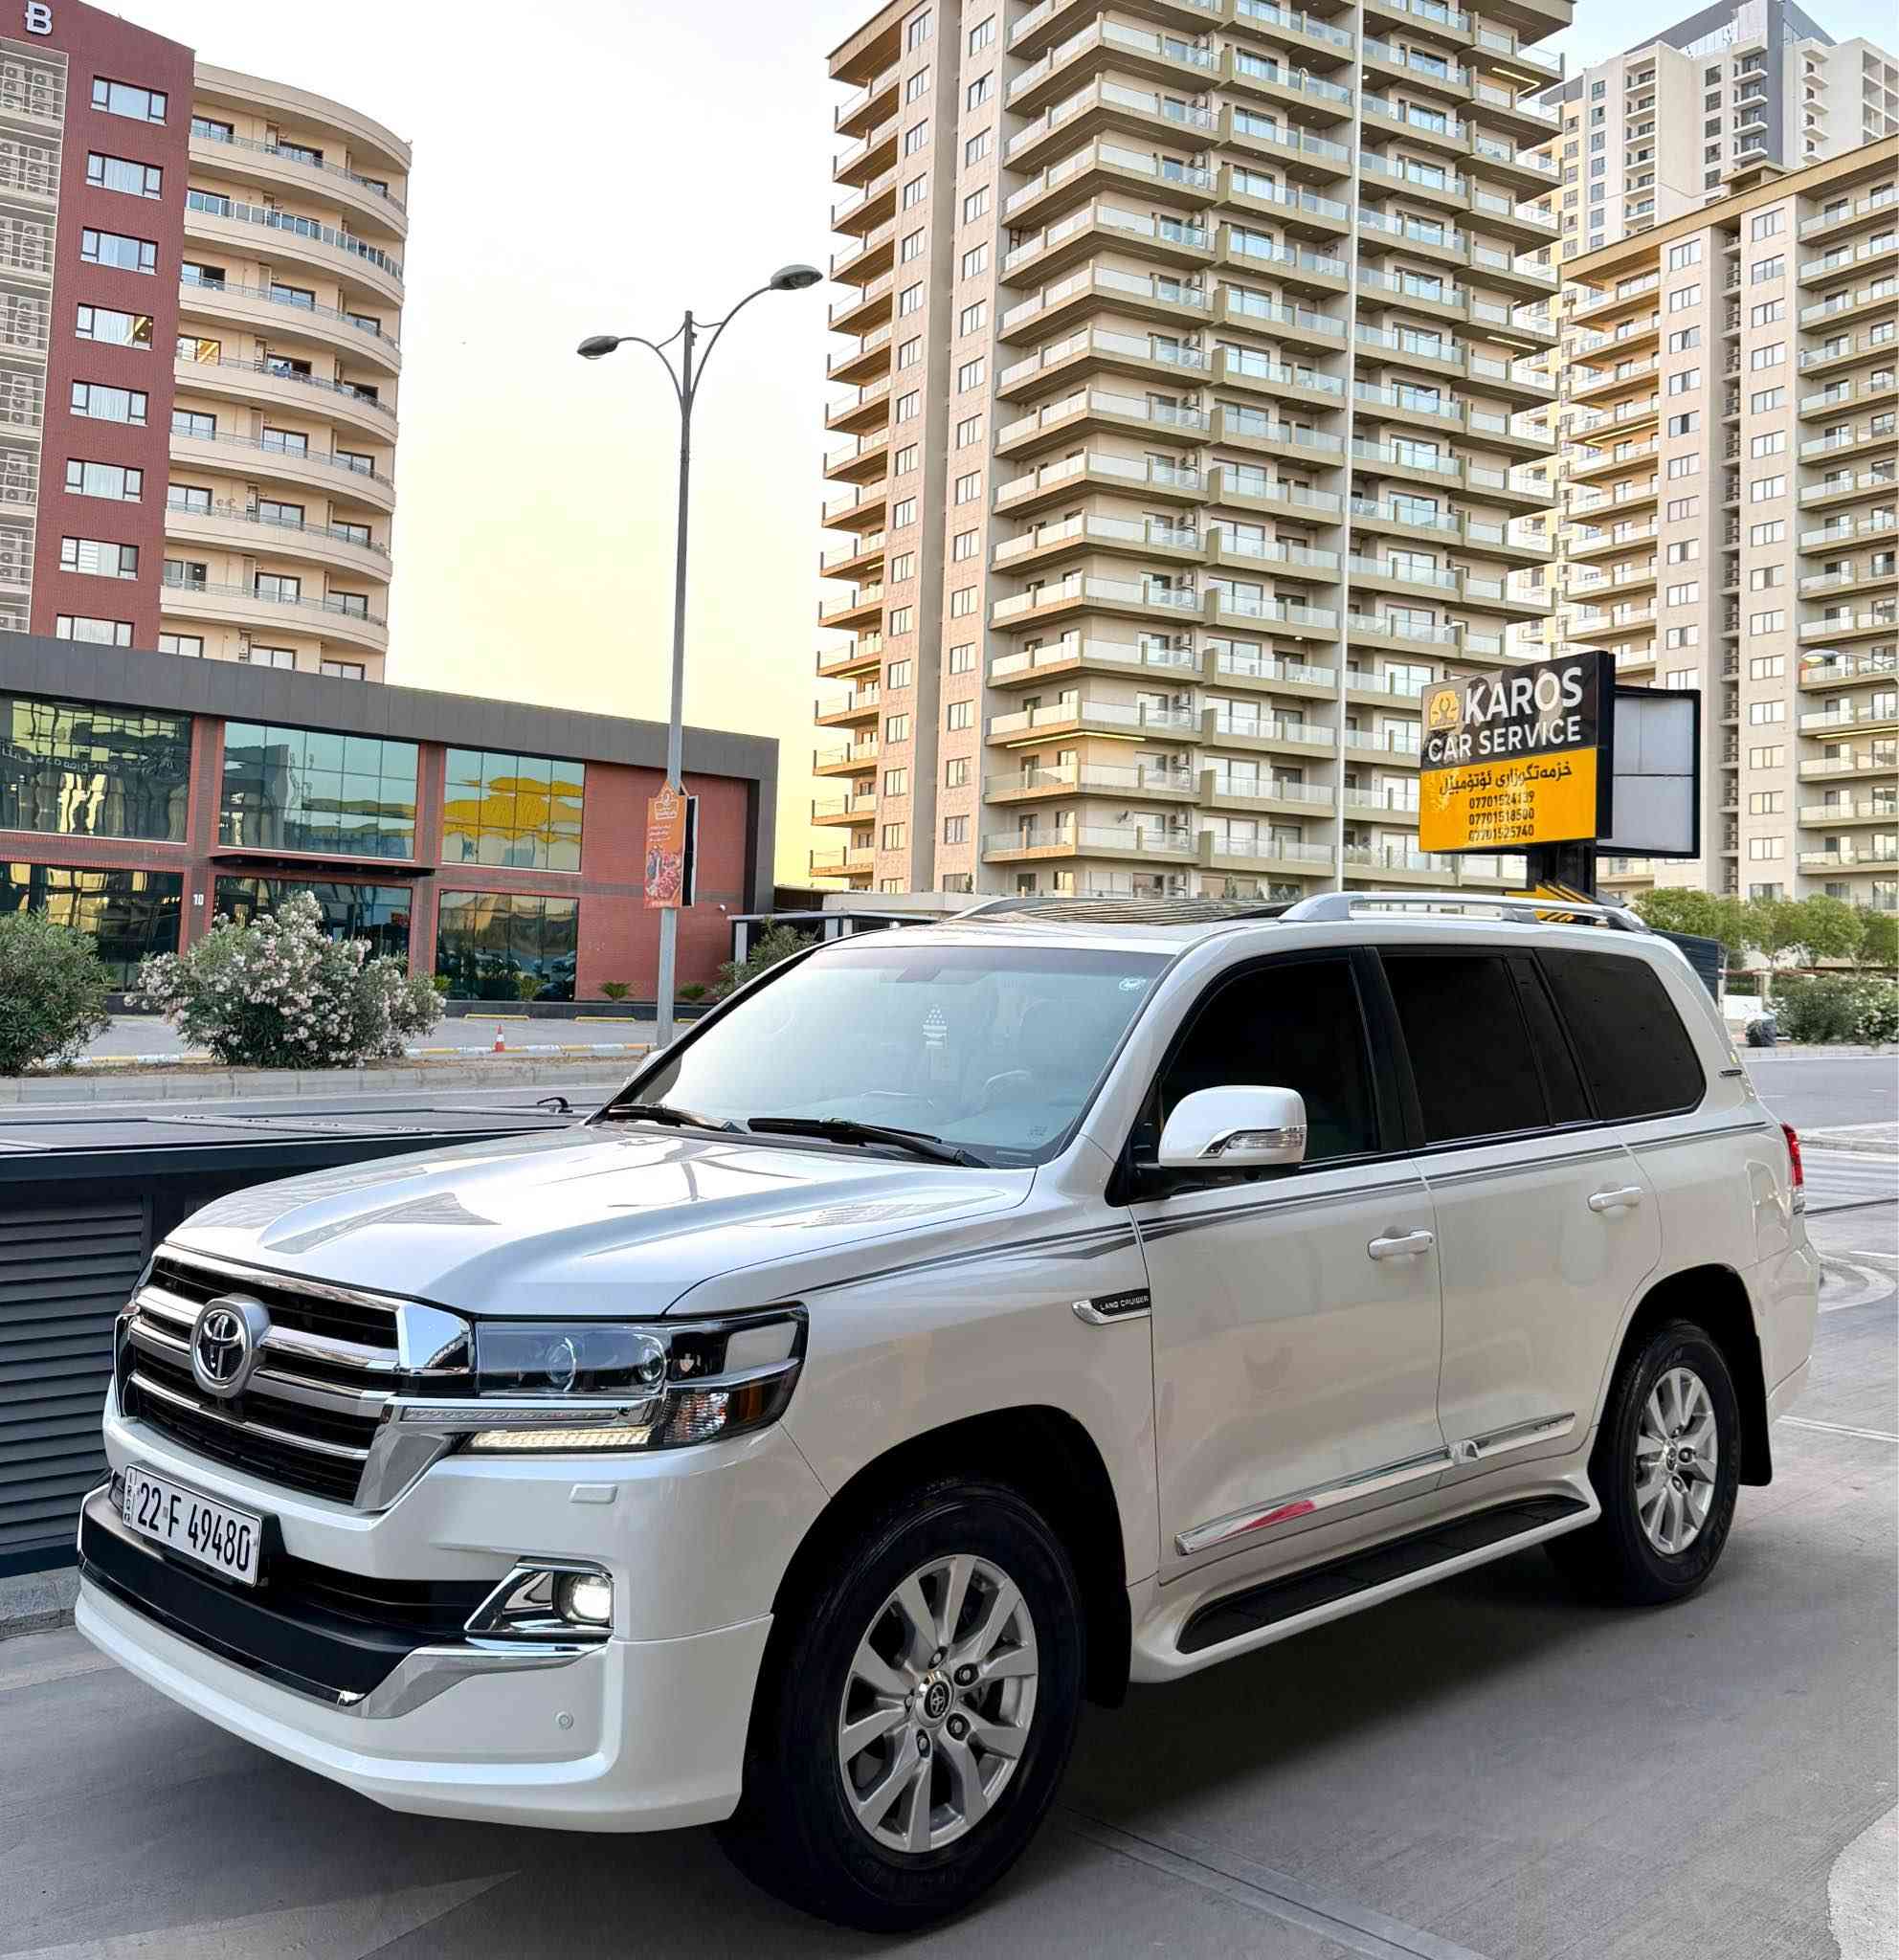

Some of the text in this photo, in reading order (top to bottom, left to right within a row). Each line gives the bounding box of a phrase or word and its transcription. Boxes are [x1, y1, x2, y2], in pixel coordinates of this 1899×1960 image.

[25, 1, 53, 35] B
[1465, 667, 1582, 724] KAROS
[1428, 715, 1581, 763] CAR SERVICE
[193, 894, 204, 905] 10
[137, 1482, 251, 1570] 22 F 49480
